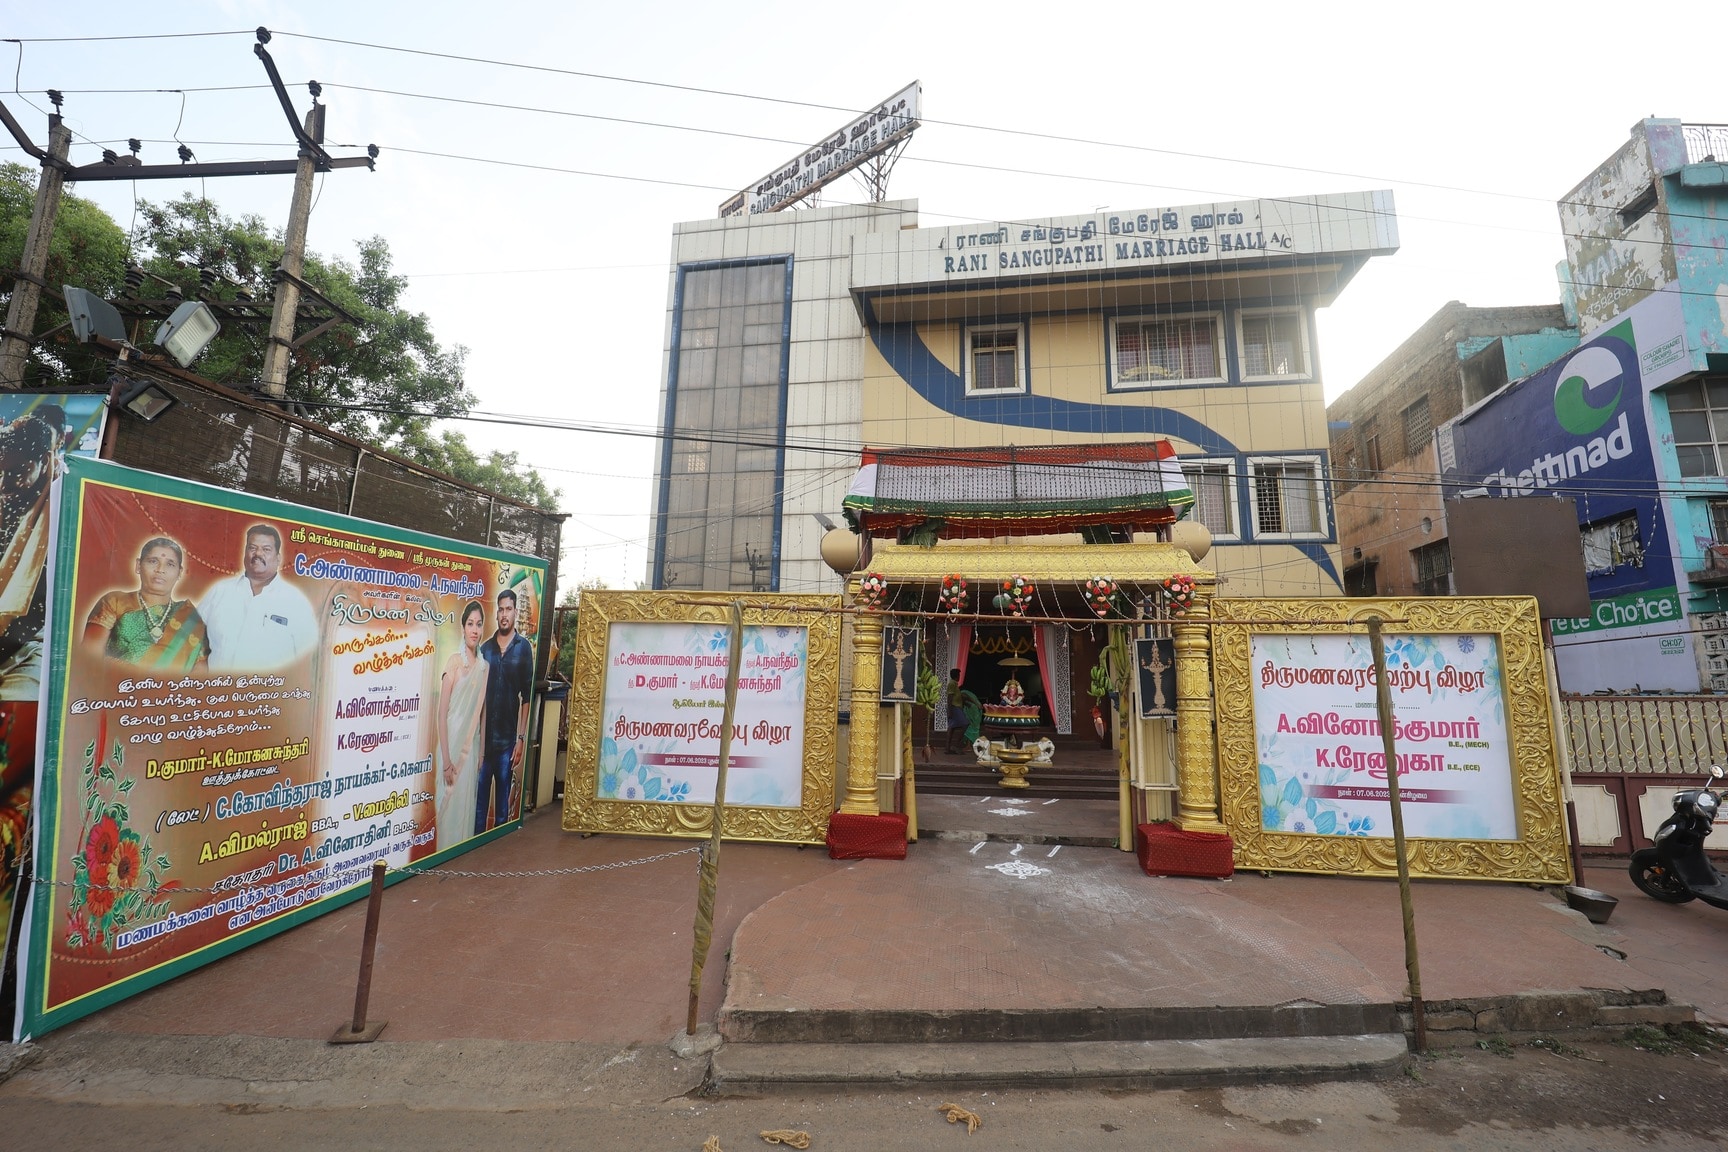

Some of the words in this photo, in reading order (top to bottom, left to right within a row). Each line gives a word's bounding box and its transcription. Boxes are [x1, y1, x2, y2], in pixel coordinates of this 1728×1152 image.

[751, 167, 814, 216] SANGUPATHI
[817, 129, 878, 179] MARRIAGE
[882, 108, 914, 140] HALL
[956, 226, 1008, 249] ராணி
[1021, 219, 1097, 245] சங்குபதி
[1109, 208, 1179, 236] மேரேஜ்
[1191, 208, 1244, 230] ஹால்
[945, 254, 988, 273] RANI
[999, 244, 1103, 269] SANGUPATHI
[1116, 237, 1210, 261] MARRIAGE
[1221, 231, 1267, 252] HALL
[1270, 231, 1292, 249] A/C
[1481, 411, 1633, 498] Chettinad
[294, 553, 421, 588] C.அண்ணாமலை
[331, 592, 410, 626] திருமண
[413, 600, 456, 627] விழா
[1596, 597, 1674, 628] Choice
[694, 653, 729, 670] நாயக்க
[118, 678, 164, 694] இனிய
[635, 673, 678, 691] D.குமார்
[701, 673, 782, 694] K.மோனசுந்தரி
[1436, 664, 1486, 693] விழா
[71, 695, 137, 713] இமயாய்
[206, 694, 229, 706] குல
[232, 690, 279, 703] பெருமை
[120, 714, 166, 728] கோபுர
[752, 720, 792, 745] விழா
[129, 731, 164, 745] வாழ
[337, 730, 394, 753] K.ரேணுகா
[1465, 741, 1490, 750] (MECH)
[1463, 764, 1480, 772] (ECE)
[277, 853, 298, 875] Dr.
[116, 901, 215, 951] மணமக்களை
[229, 913, 251, 930] என
